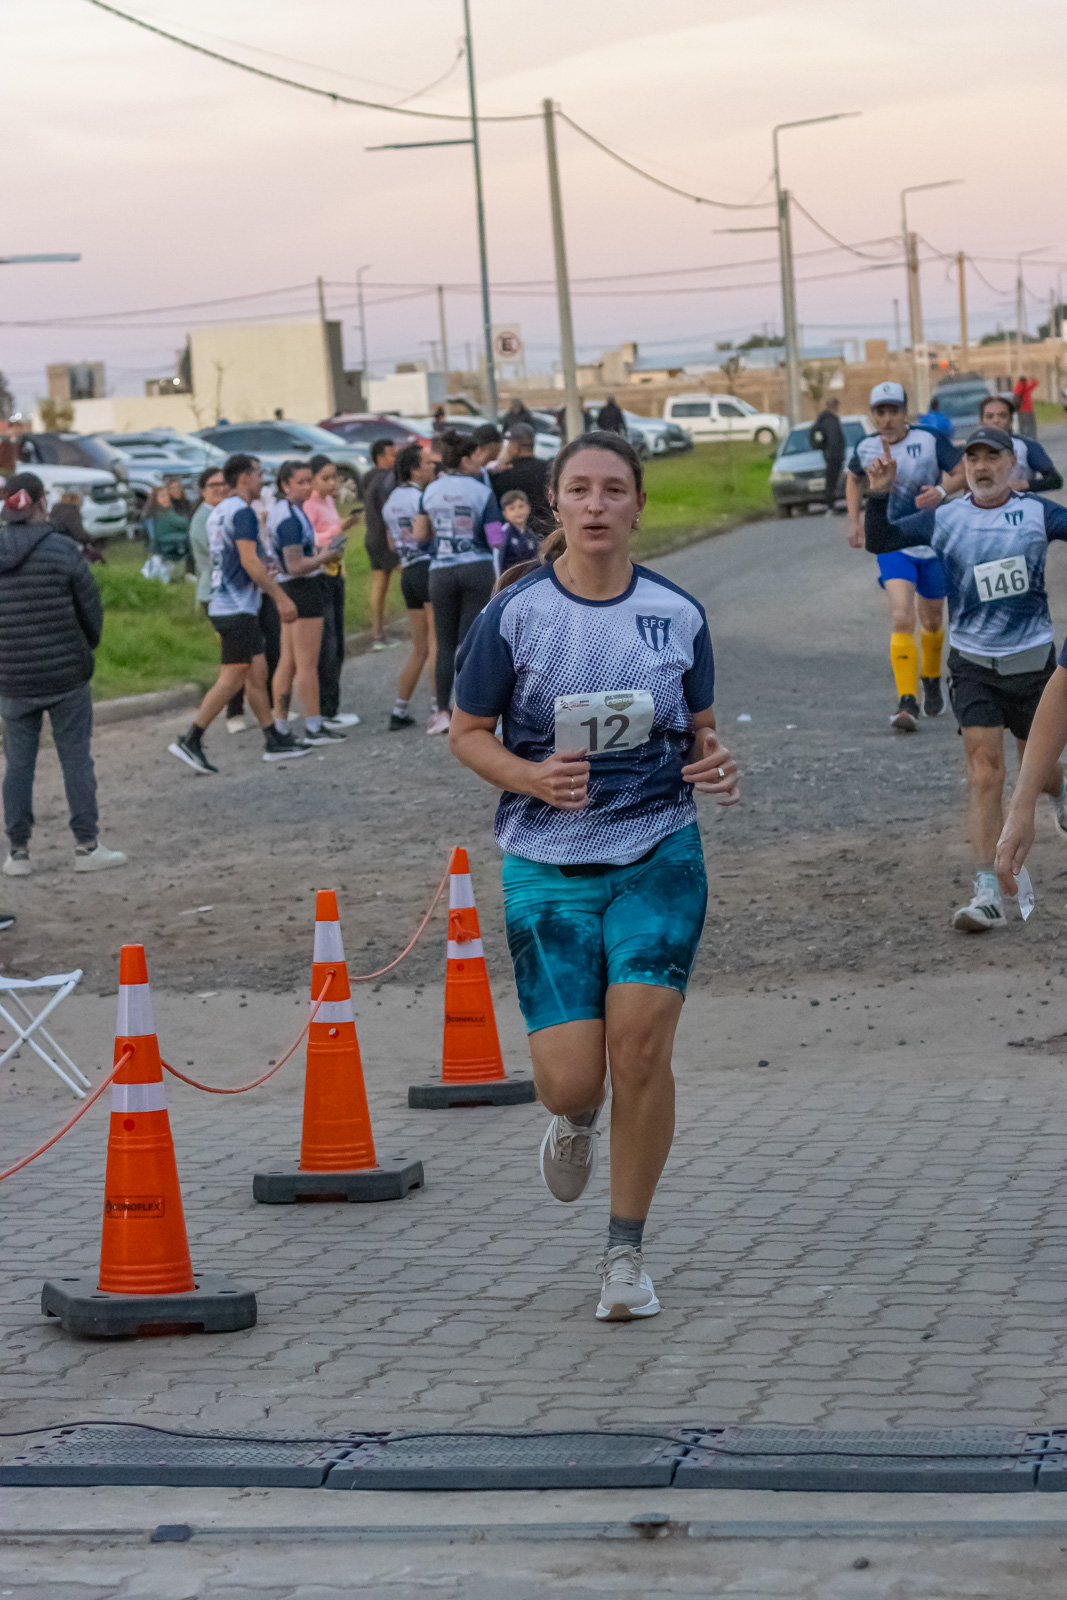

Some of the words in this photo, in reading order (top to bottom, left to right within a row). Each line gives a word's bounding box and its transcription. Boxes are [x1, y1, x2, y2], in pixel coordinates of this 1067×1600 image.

[980, 569, 1026, 598] 146
[642, 618, 665, 629] SFC
[580, 714, 630, 752] 12
